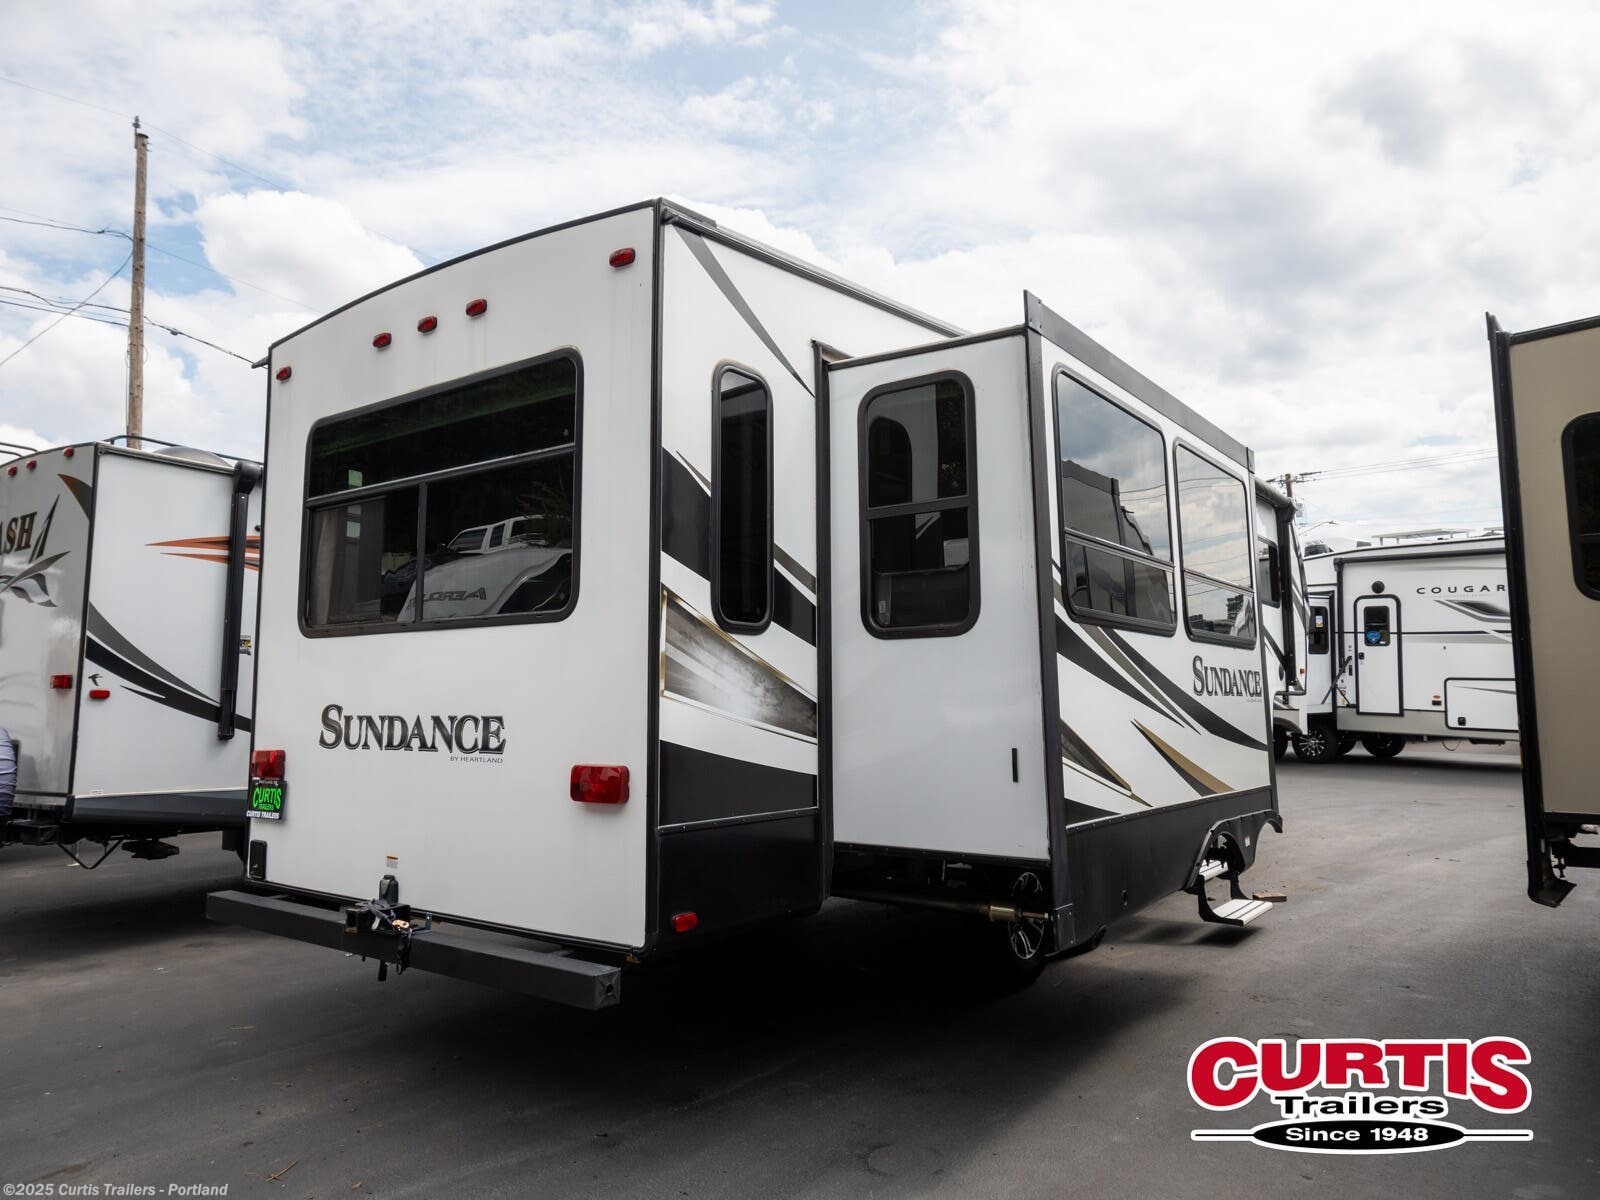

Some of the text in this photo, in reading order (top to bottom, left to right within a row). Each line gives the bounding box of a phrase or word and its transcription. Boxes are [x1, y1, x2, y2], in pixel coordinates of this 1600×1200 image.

[1416, 584, 1506, 595] COUGAR
[1192, 655, 1262, 698] SUNDANCE
[318, 703, 506, 755] SUNDANCE
[460, 756, 503, 764] HEARTLAND
[253, 787, 282, 809] CURTIS
[246, 810, 261, 818] CURTIS
